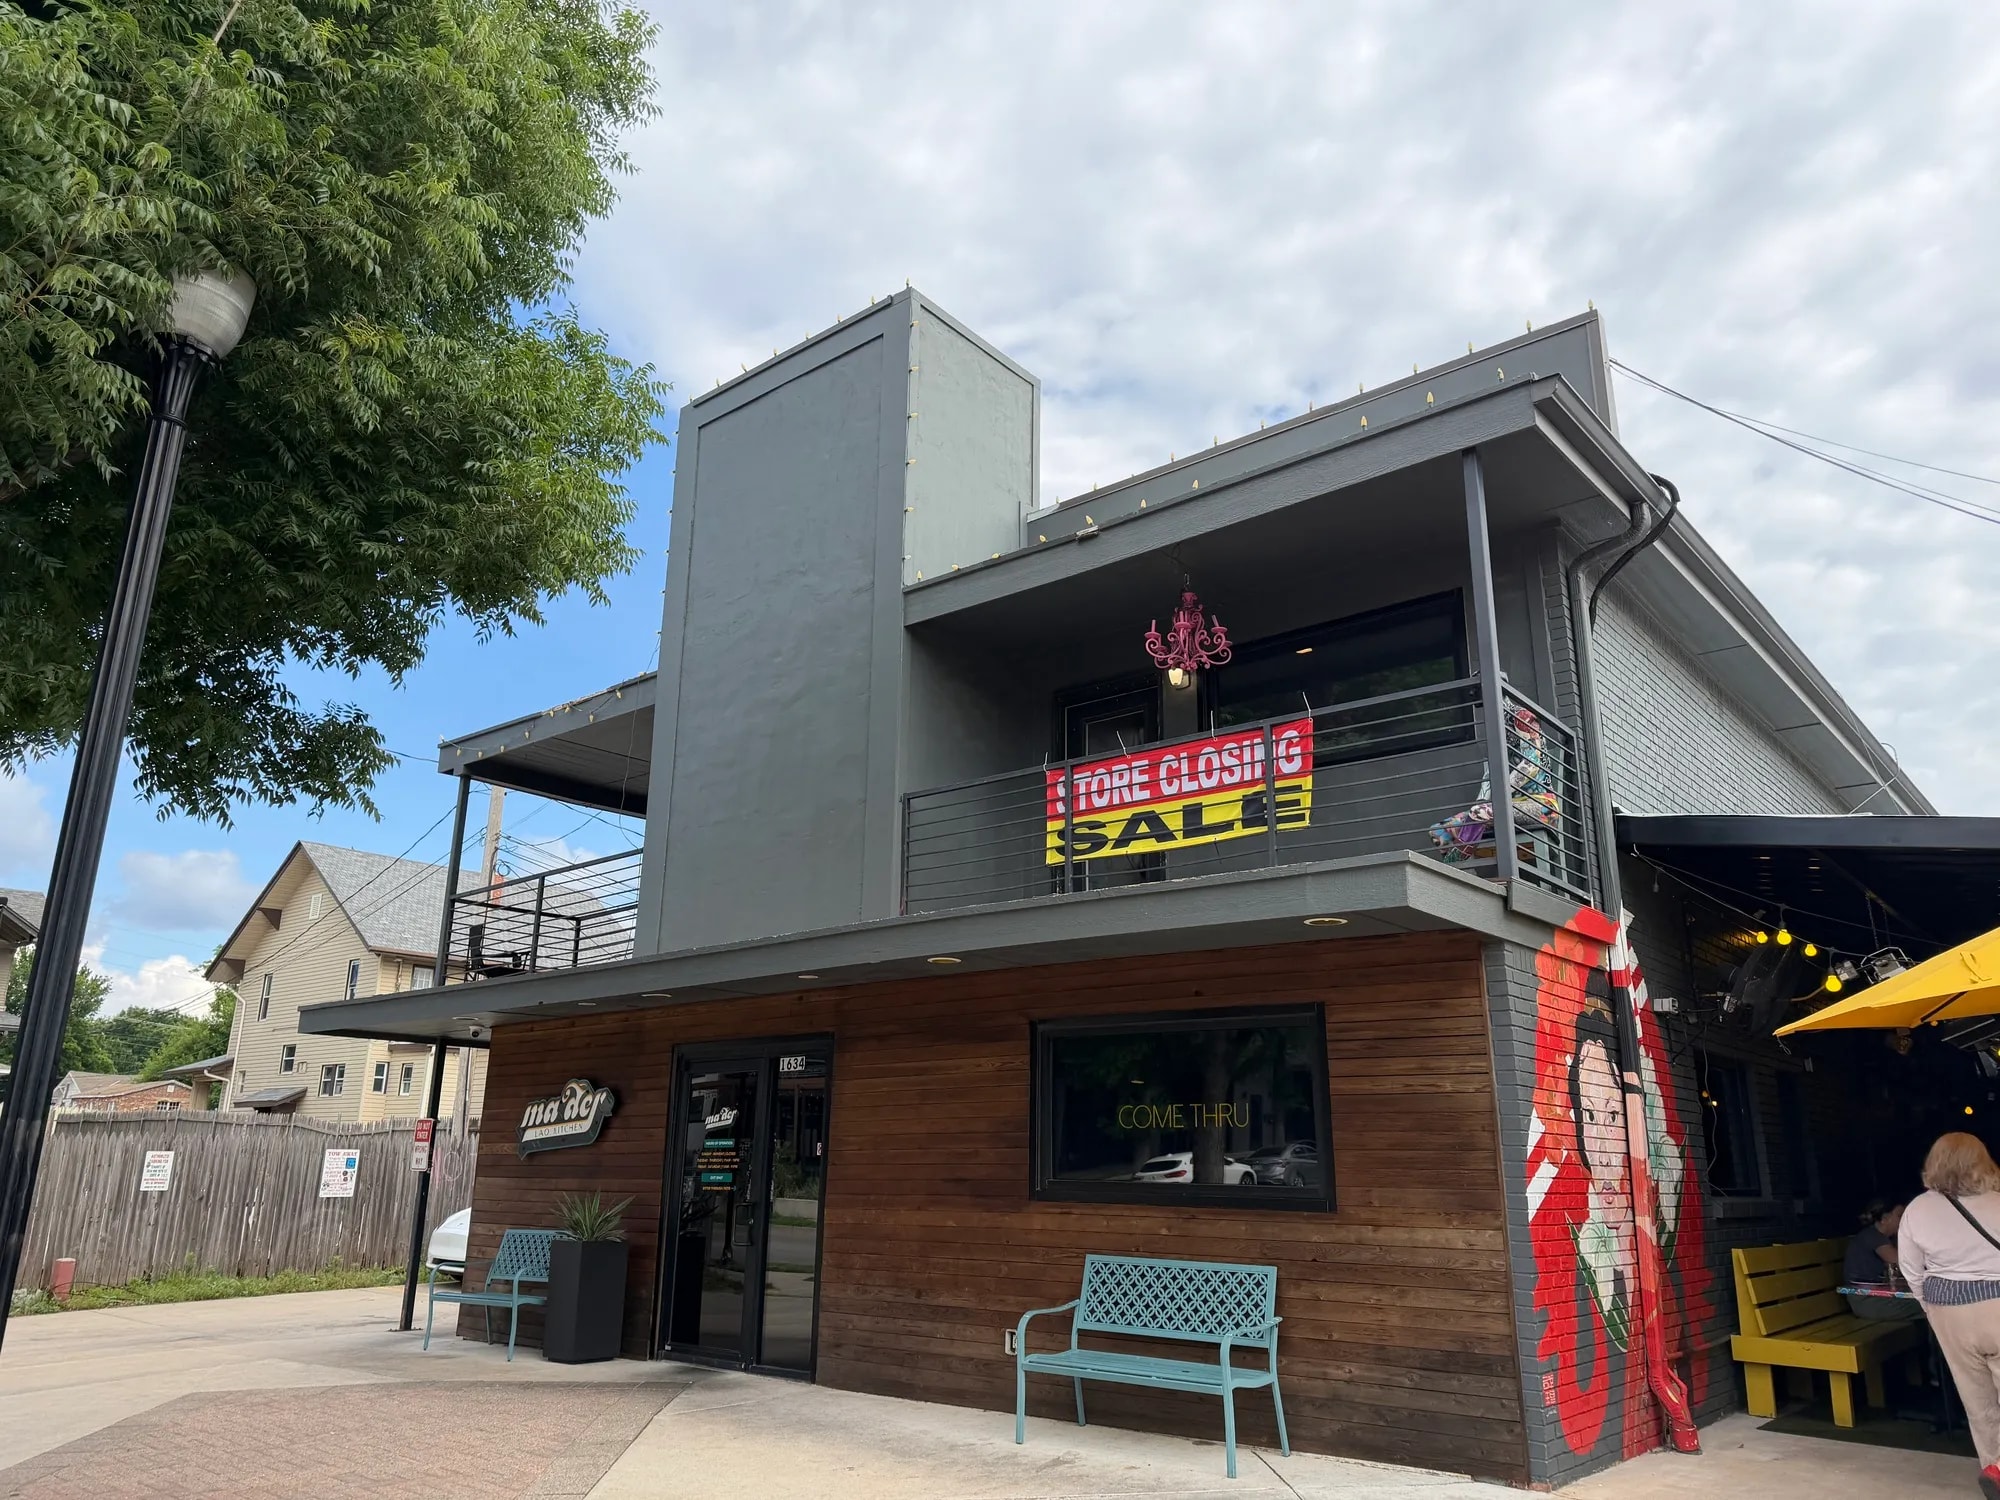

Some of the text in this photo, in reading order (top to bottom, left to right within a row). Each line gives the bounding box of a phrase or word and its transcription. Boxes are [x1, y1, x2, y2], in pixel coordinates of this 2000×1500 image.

[1159, 730, 1302, 795] CLOSING
[1055, 784, 1306, 857] SALE
[781, 1057, 805, 1071] 1634
[1118, 1102, 1249, 1129] COME THRU
[534, 1128, 550, 1138] LAO
